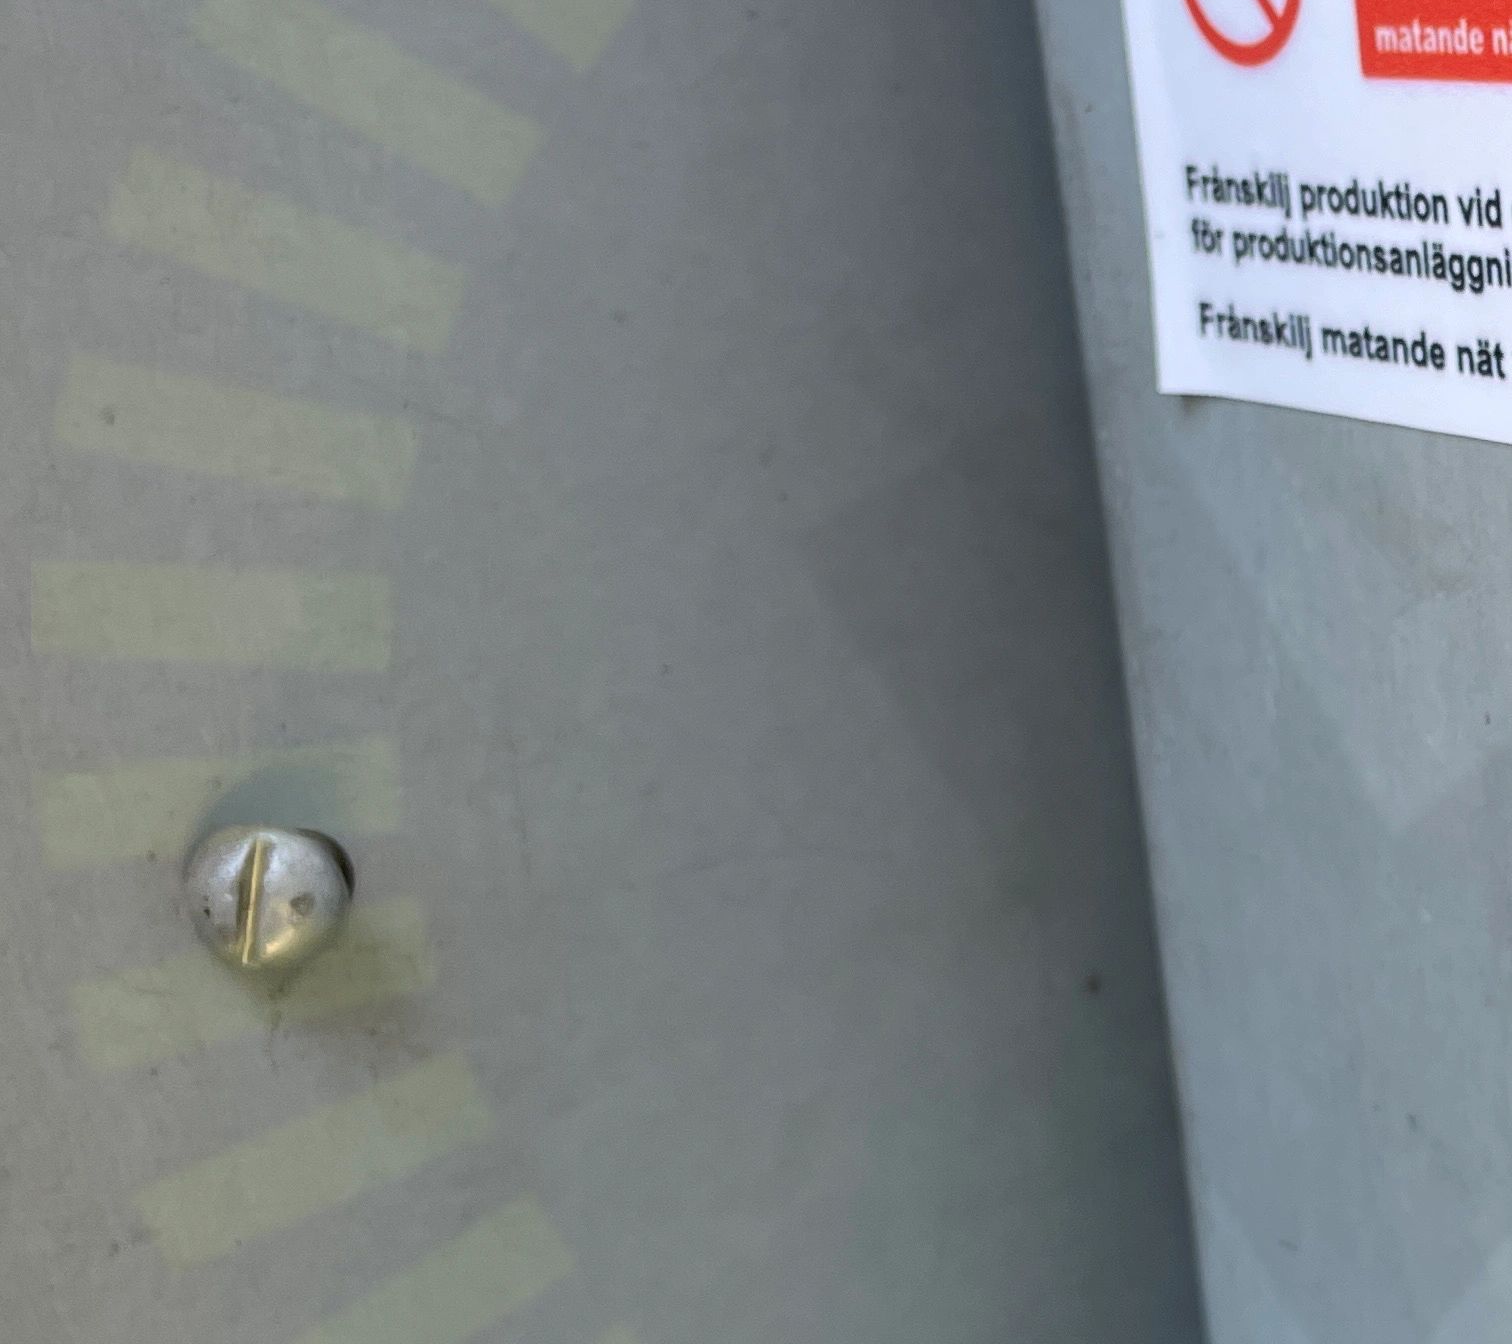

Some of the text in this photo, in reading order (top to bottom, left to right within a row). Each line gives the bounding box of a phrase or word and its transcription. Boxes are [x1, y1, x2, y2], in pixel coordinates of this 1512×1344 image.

[1374, 18, 1485, 57] matande
[1185, 163, 1293, 218] Frånskilj
[1300, 182, 1450, 233] produktion
[1457, 187, 1502, 228] vid
[1190, 216, 1225, 254] för
[1197, 301, 1313, 360] Frånskilj
[1321, 321, 1446, 369] matande
[1456, 338, 1505, 378] nät
